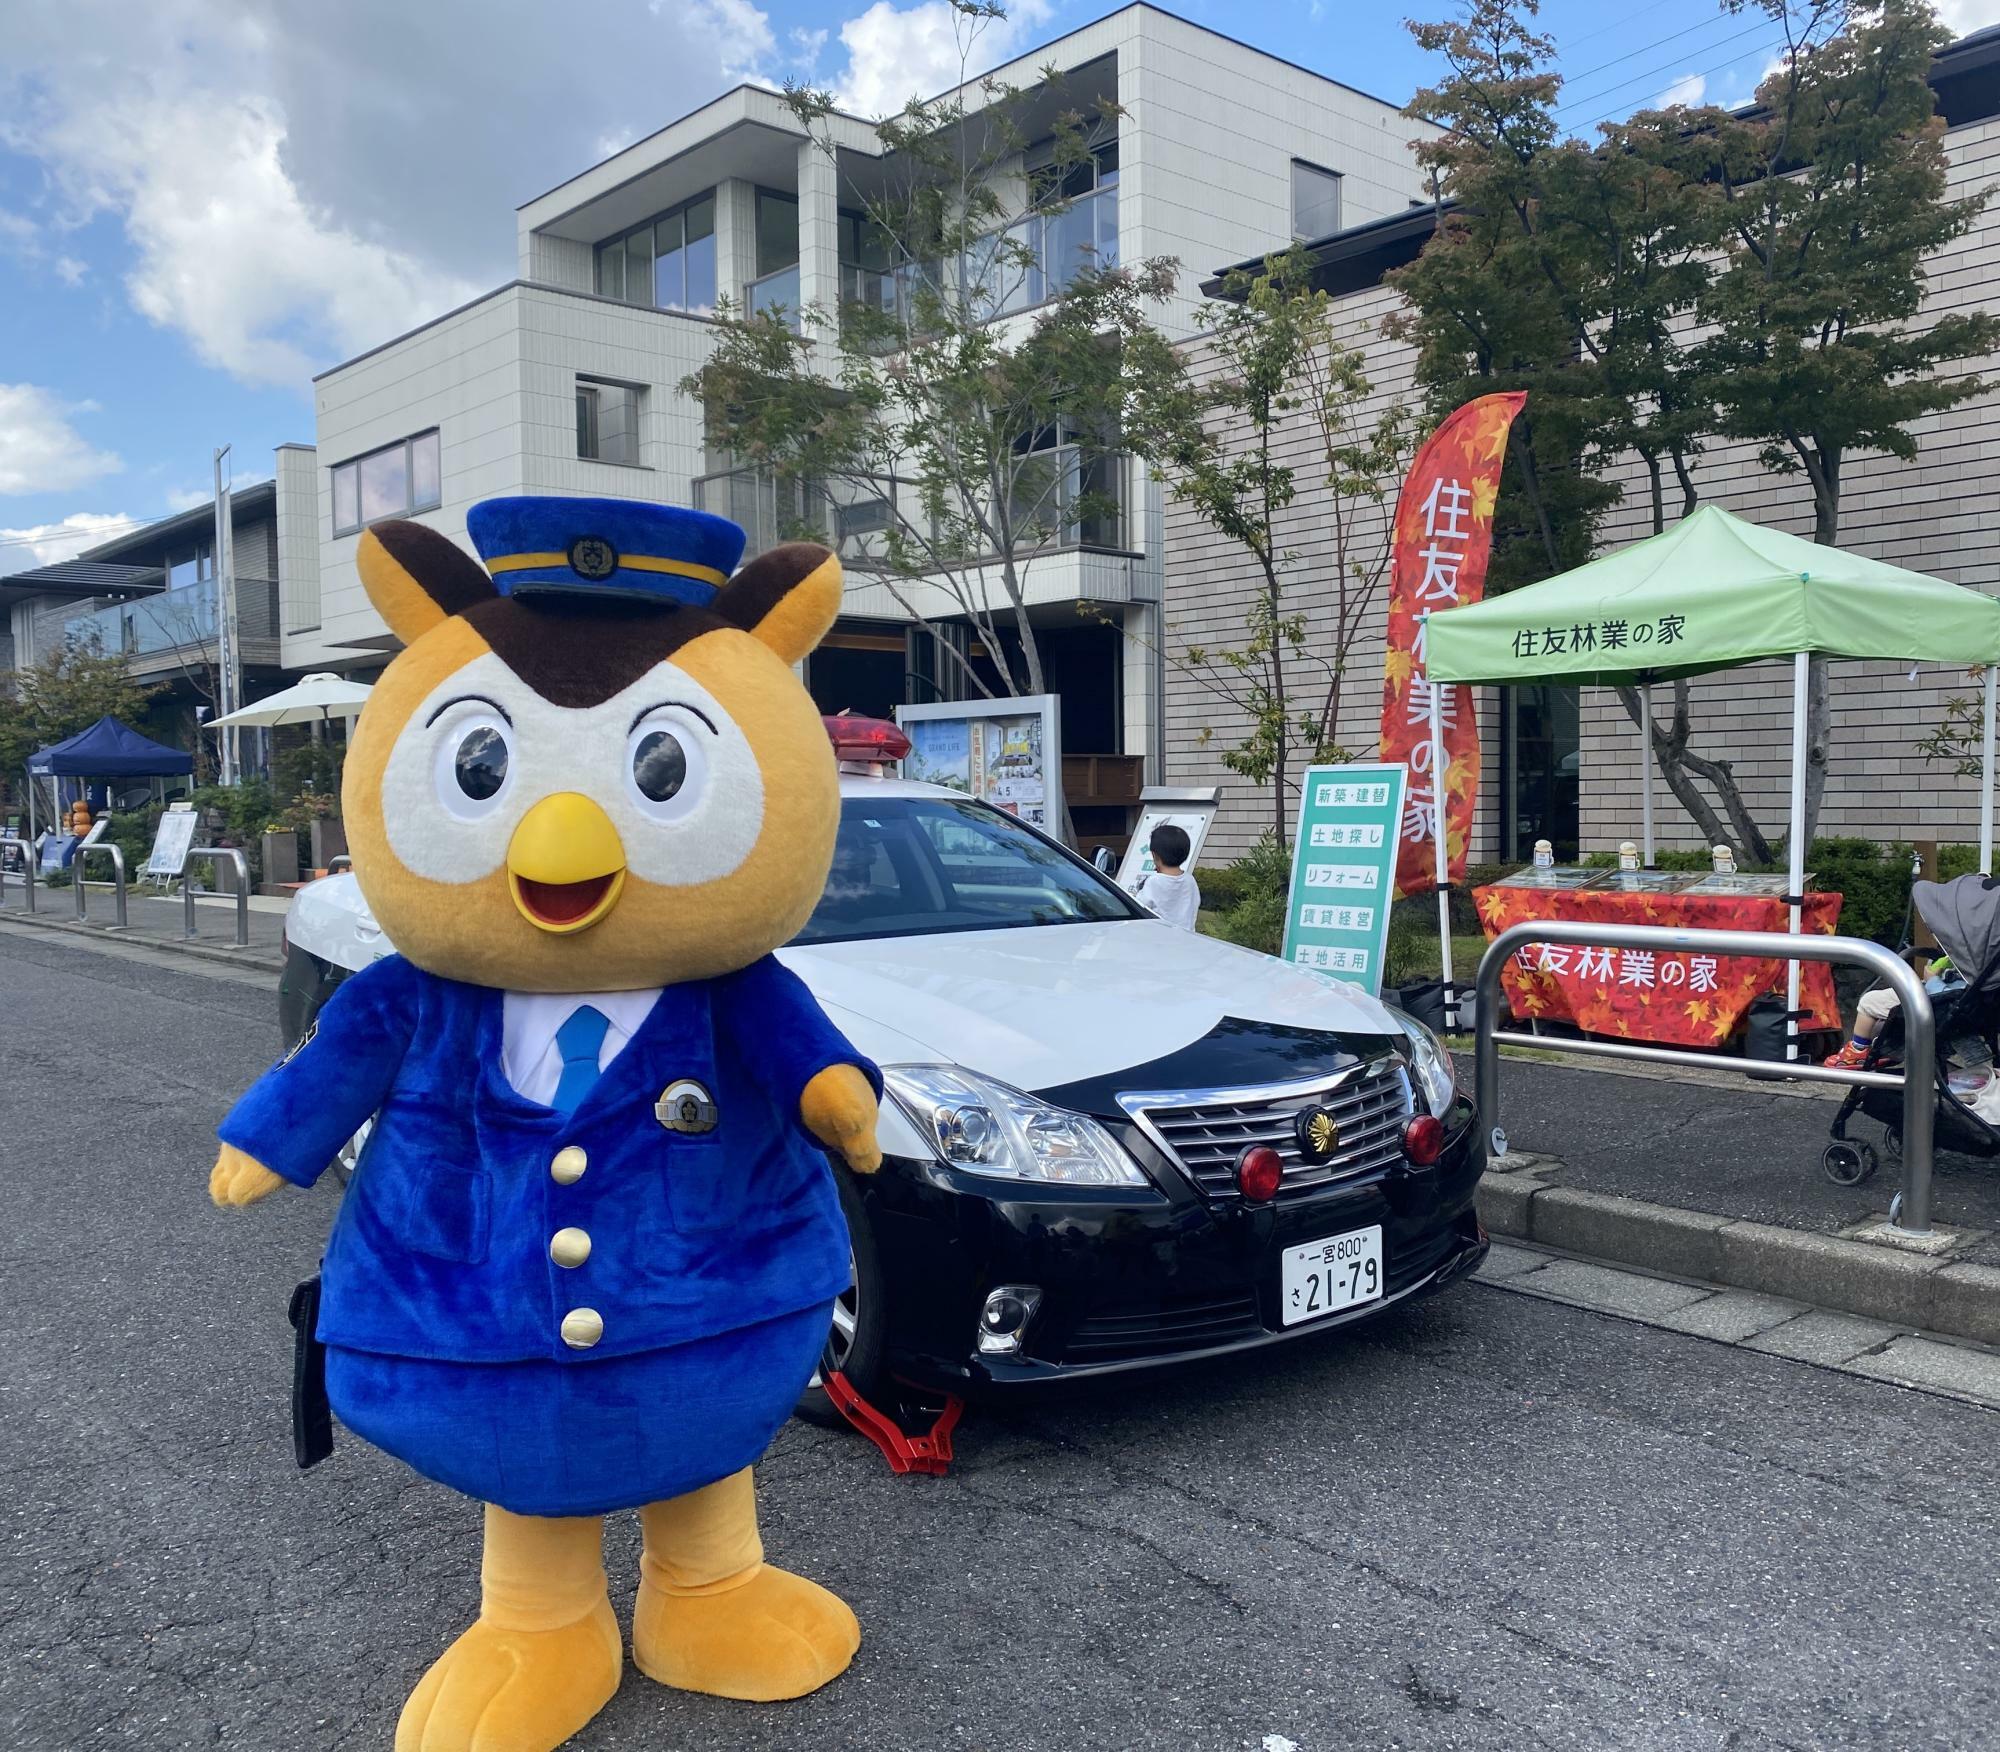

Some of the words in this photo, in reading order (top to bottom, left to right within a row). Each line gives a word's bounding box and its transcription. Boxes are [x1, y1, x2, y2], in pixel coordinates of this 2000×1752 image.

[1512, 614, 1686, 658] 住友林業の家
[1313, 828, 1380, 844] 土地探し
[1308, 869, 1374, 885] リフォーム
[1302, 908, 1370, 927] 賃貸経営
[1298, 950, 1365, 969] 土地活用
[1291, 1287, 1300, 1307] さ
[1306, 1257, 1378, 1312] 21-79
